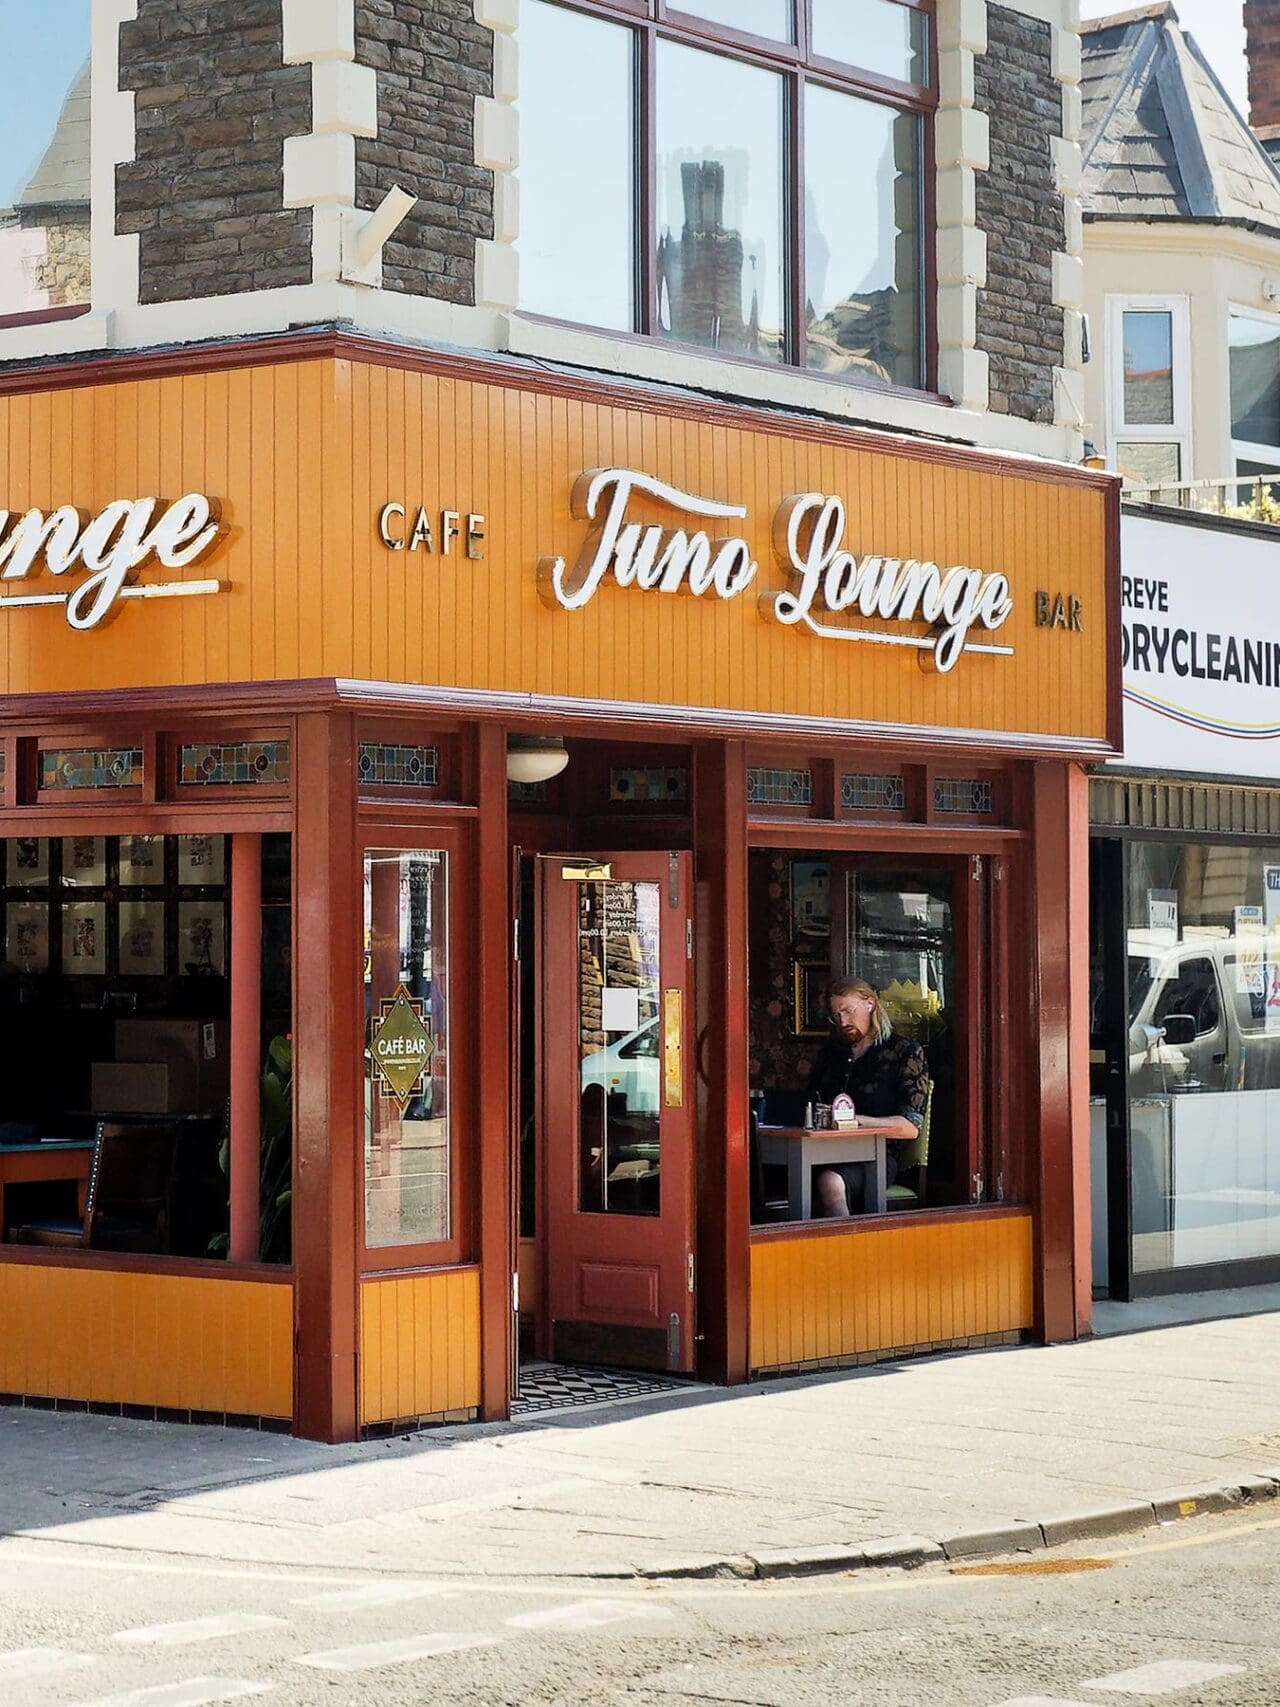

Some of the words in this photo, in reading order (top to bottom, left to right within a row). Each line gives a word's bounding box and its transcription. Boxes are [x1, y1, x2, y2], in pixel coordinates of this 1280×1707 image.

[380, 502, 485, 560] CAFE
[550, 467, 758, 611] Juno
[772, 492, 1016, 674] Lounge
[1035, 590, 1084, 632] BAR
[377, 1035, 405, 1055] CAFÉ
[405, 1039, 426, 1055] BAR
